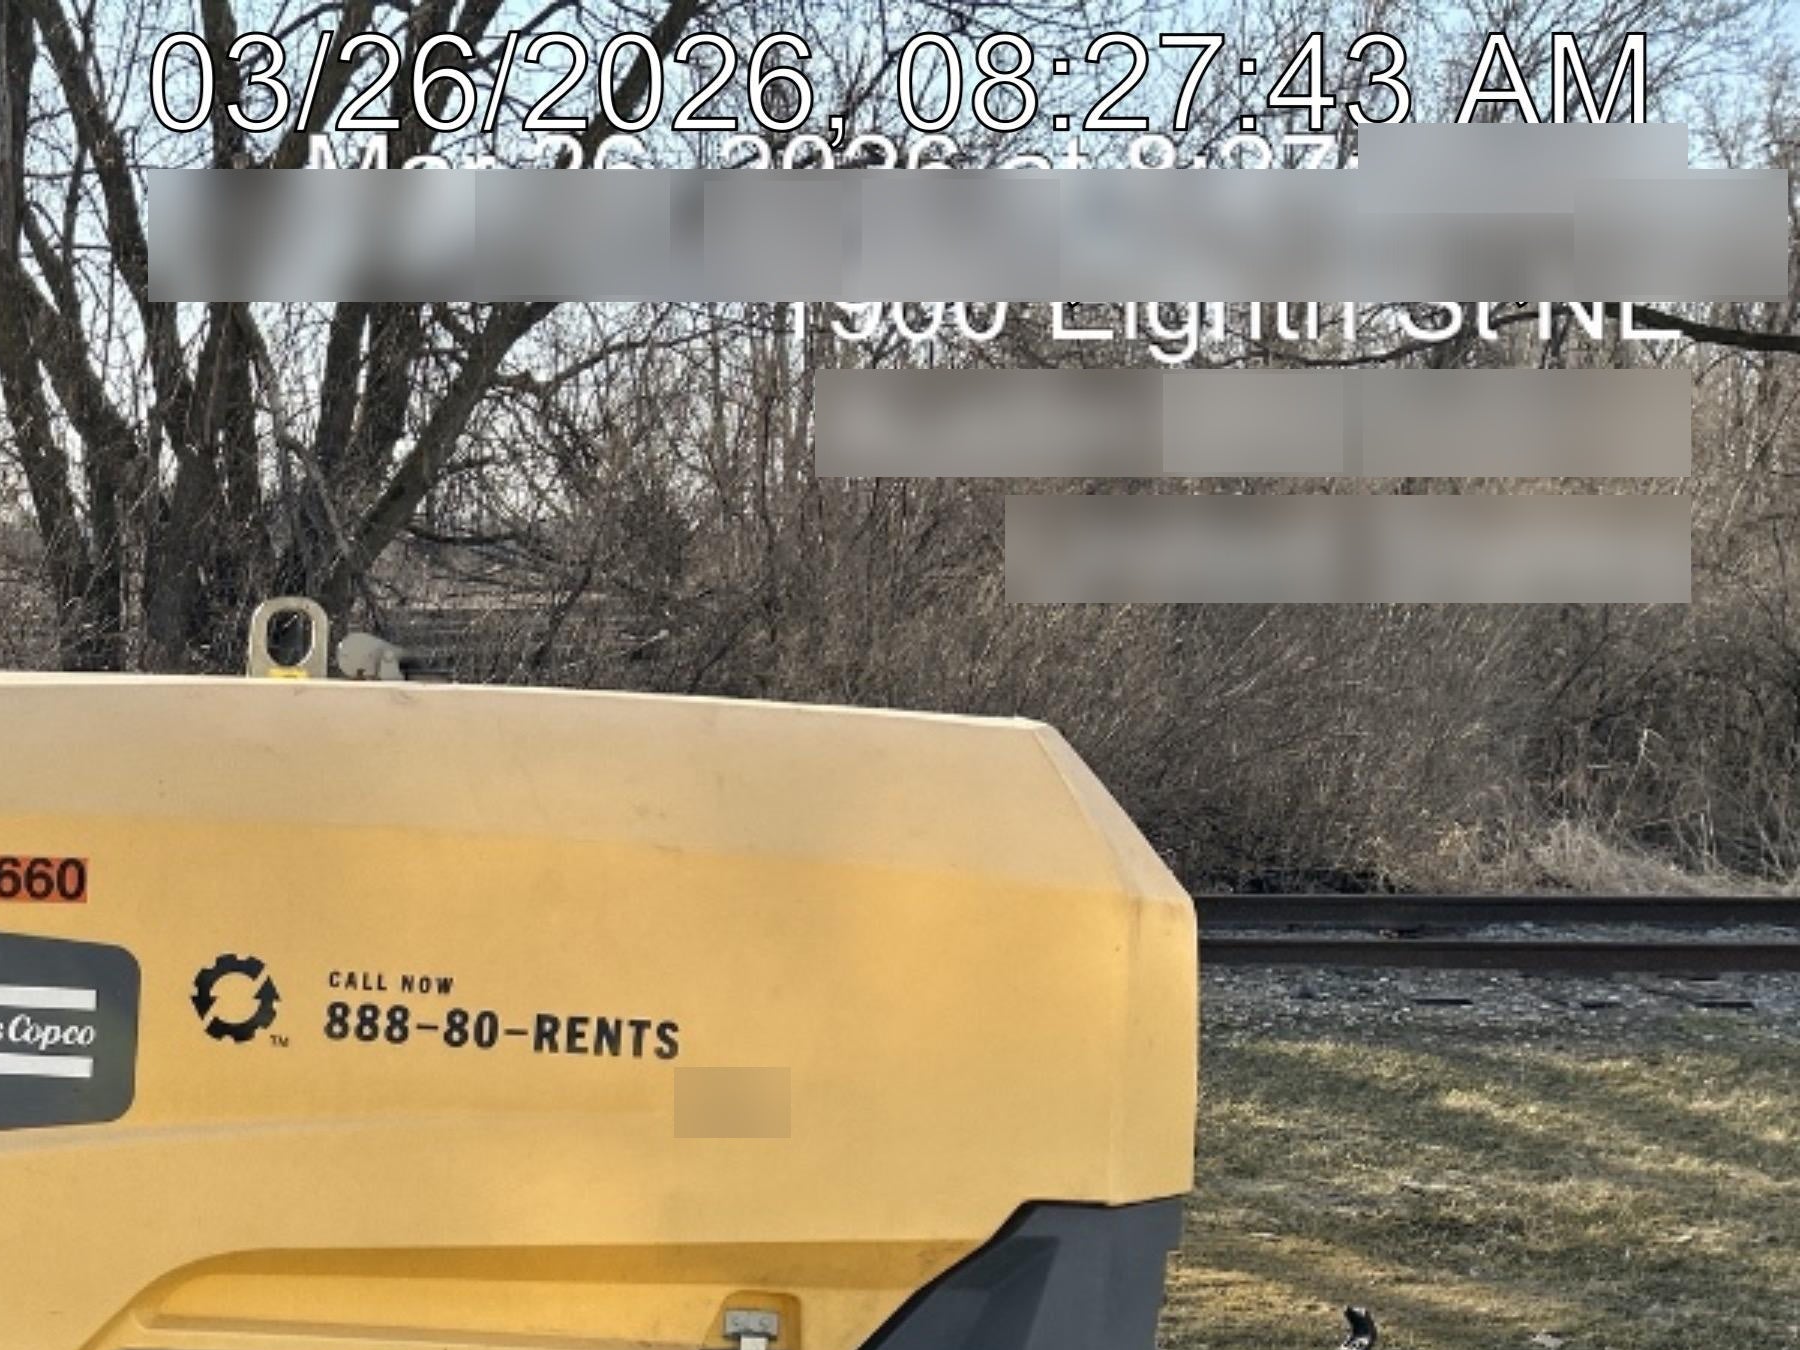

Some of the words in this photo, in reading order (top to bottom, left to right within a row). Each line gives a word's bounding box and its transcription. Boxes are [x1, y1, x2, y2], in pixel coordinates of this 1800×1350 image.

[328, 970, 388, 991] CALL
[401, 975, 454, 995] NOW
[7, 1014, 97, 1050] Copco
[323, 1001, 680, 1060] 888-80-RENTS
